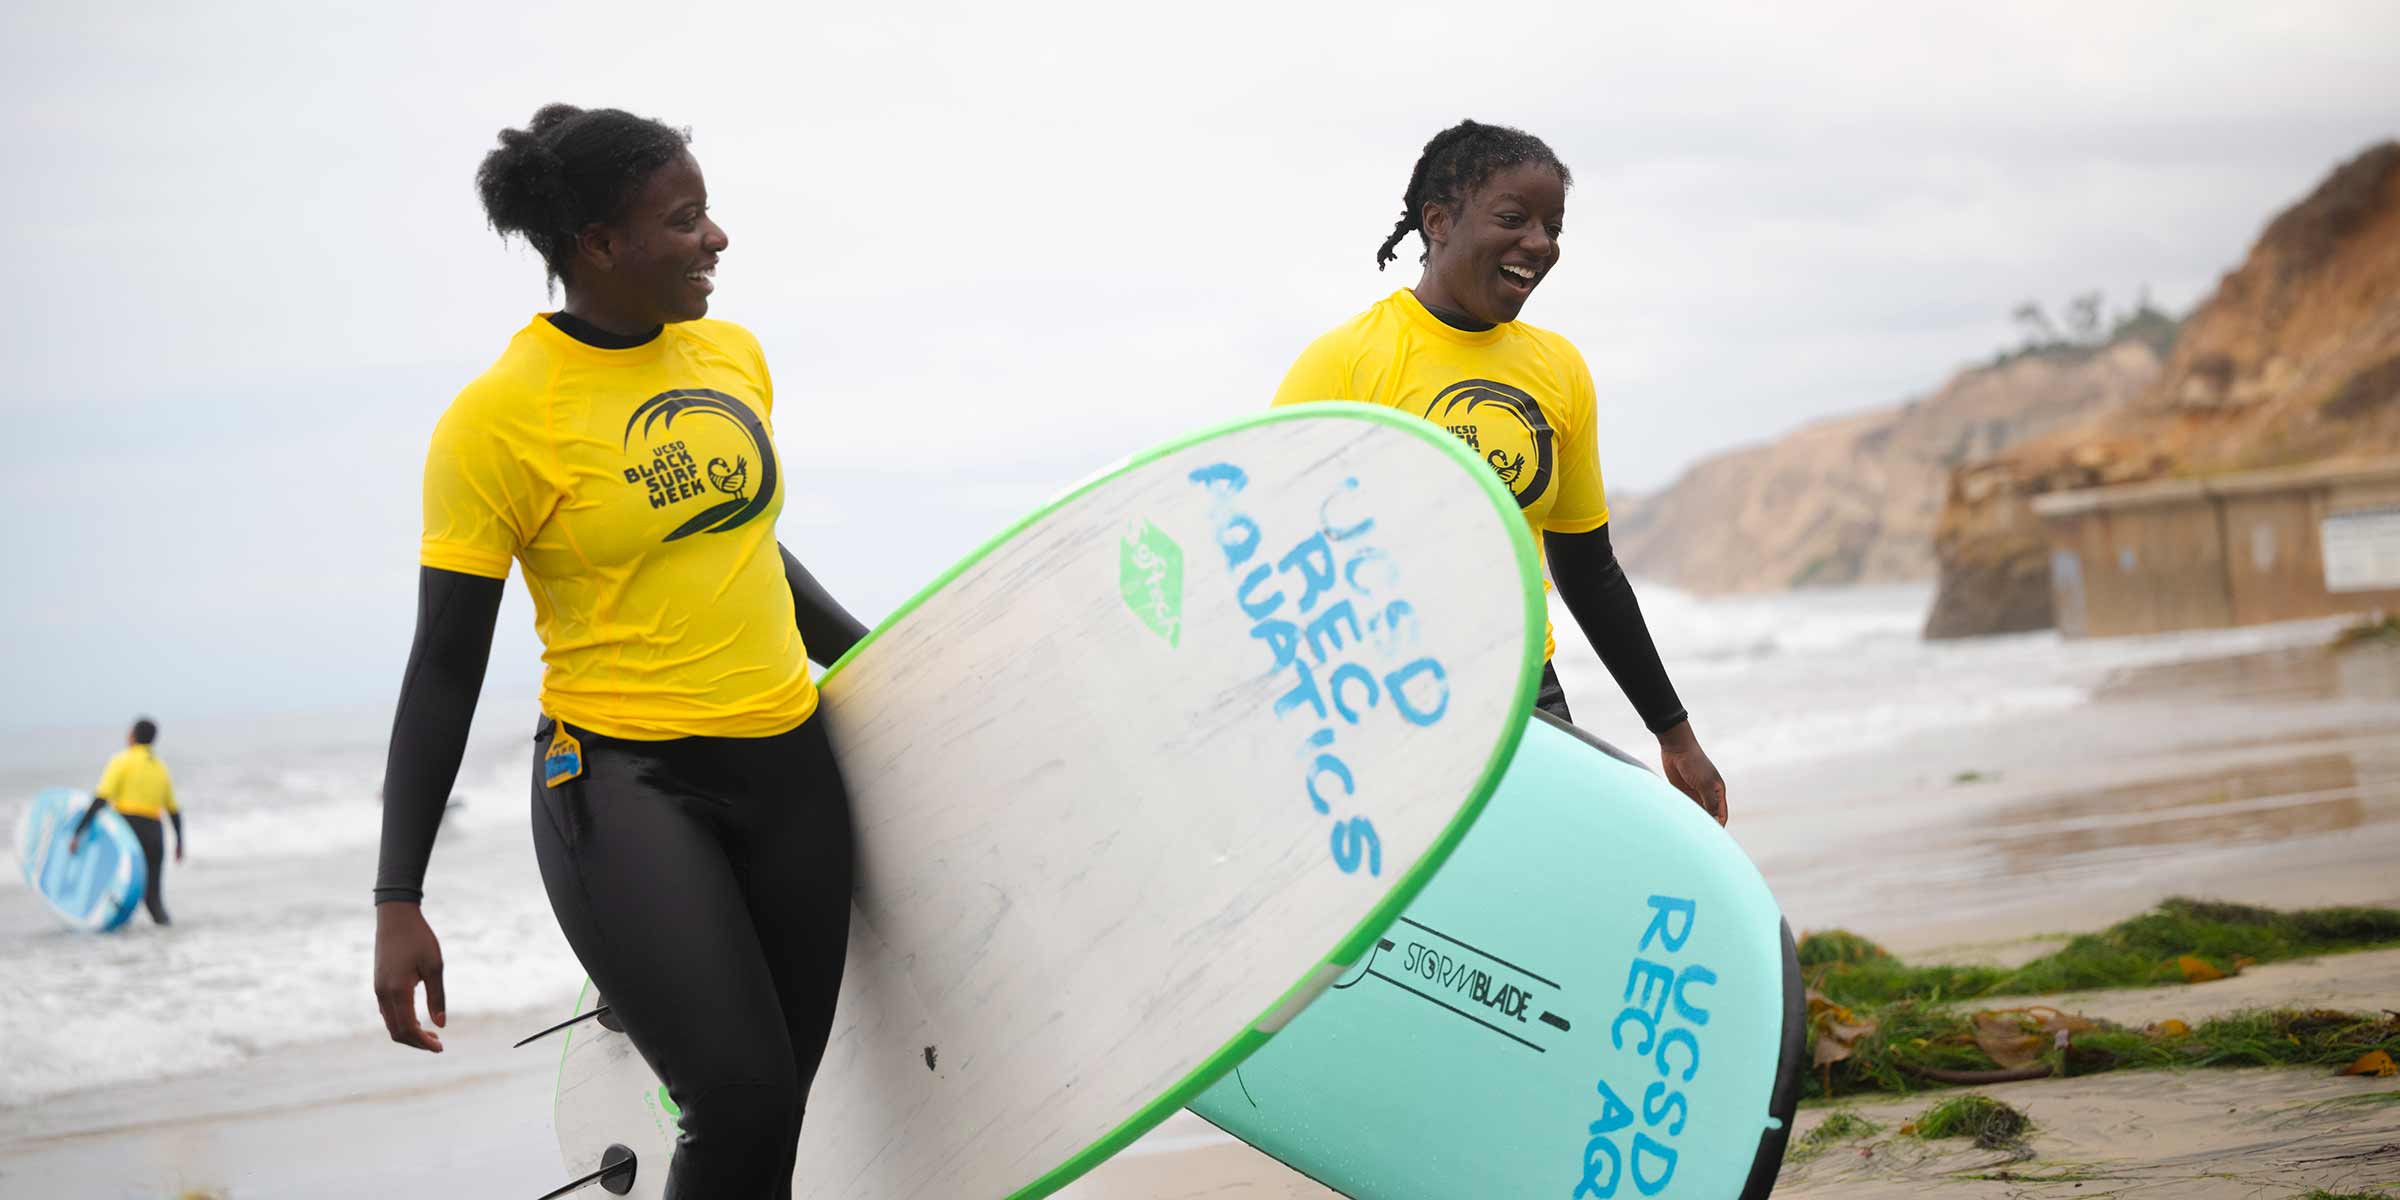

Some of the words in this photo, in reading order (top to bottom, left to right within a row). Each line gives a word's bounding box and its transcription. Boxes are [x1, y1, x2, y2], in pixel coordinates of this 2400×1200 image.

[624, 450, 694, 484] BLACK
[645, 464, 699, 493] SURF
[649, 479, 706, 509] WEEK
[653, 440, 685, 457] UCSD
[1278, 532, 1379, 725] REC
[1321, 476, 1450, 727] UCSD
[1611, 894, 1696, 1056] REC
[1573, 1079, 1634, 1200] AQ
[1631, 964, 1718, 1196] UCSD
